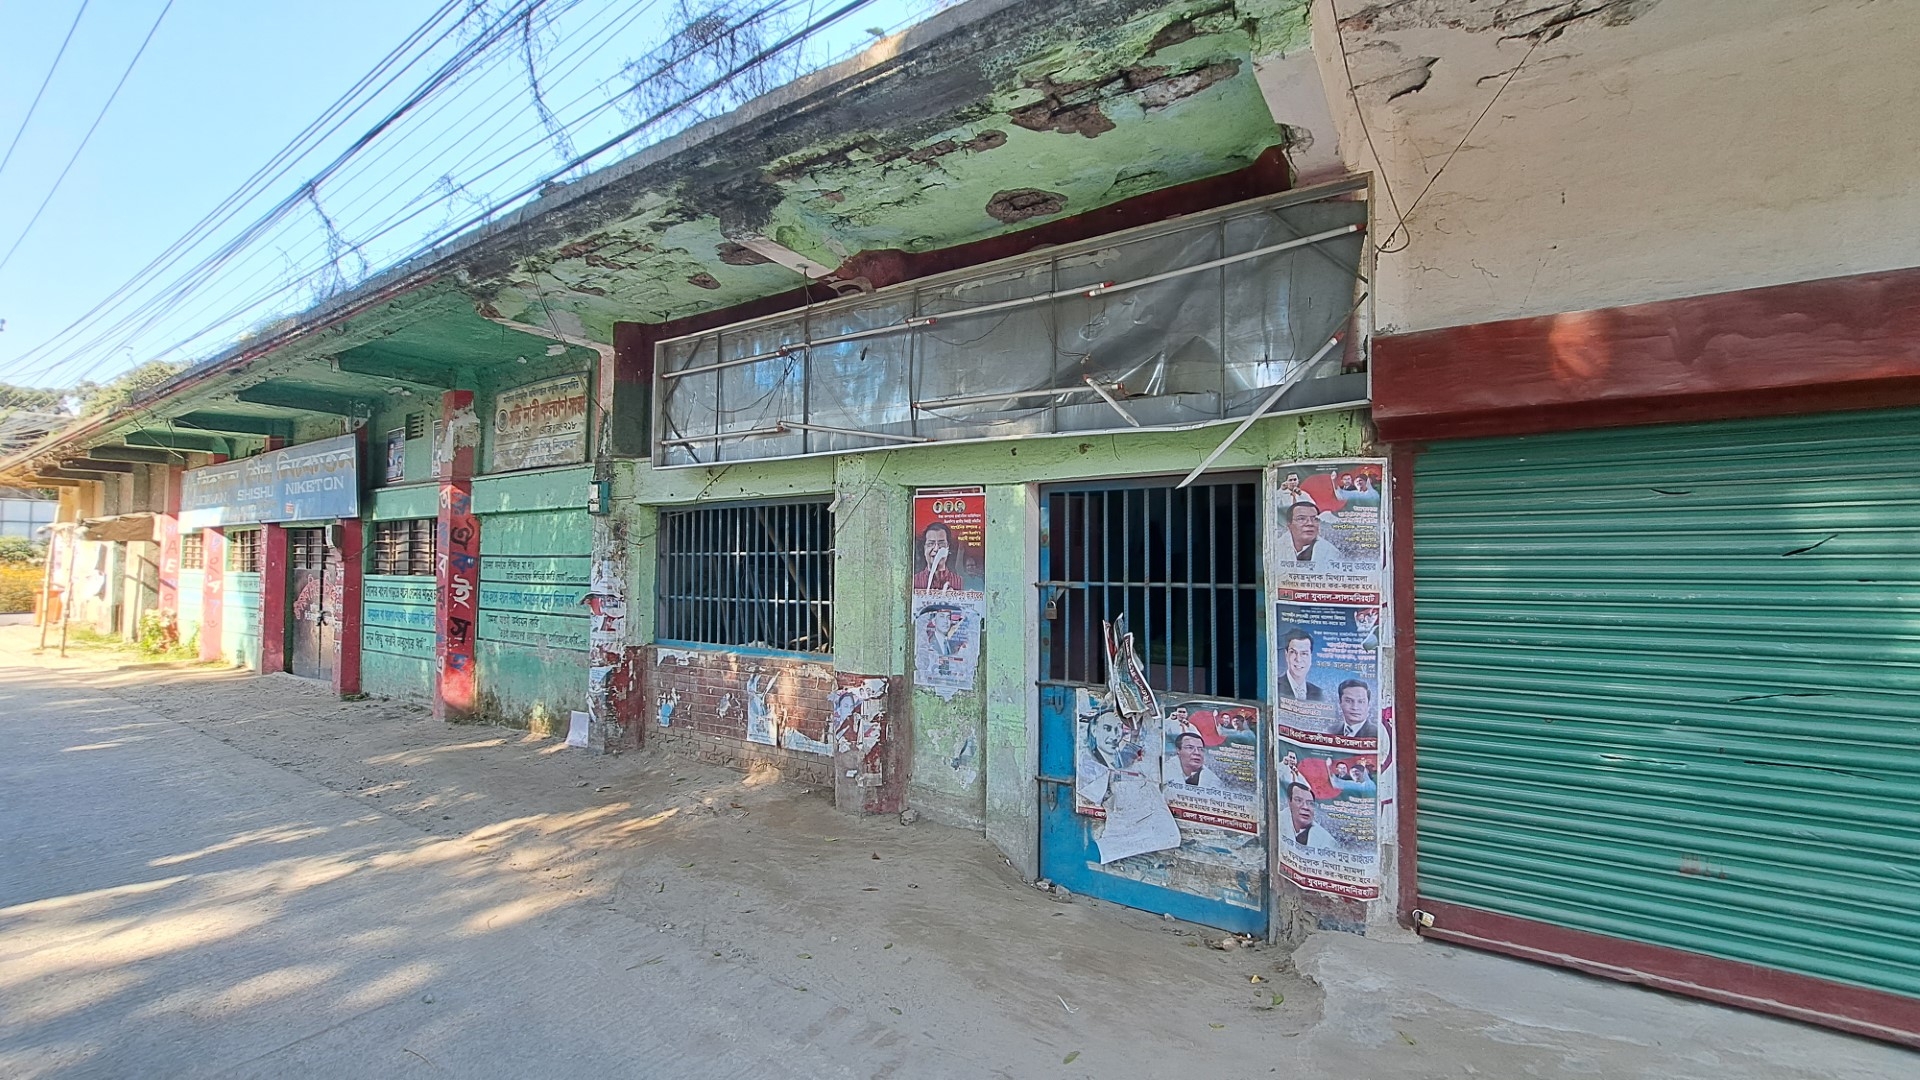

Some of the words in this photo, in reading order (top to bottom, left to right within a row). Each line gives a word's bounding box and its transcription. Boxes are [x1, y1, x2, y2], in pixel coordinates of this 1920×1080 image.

[237, 485, 274, 502] SHISHU
[285, 476, 344, 496] NIKETON
[1326, 572, 1344, 582] মিথ্যা
[1346, 574, 1368, 582] মামলা
[1334, 737, 1362, 748] উপজেলা
[1317, 846, 1336, 858] হাবিব
[1338, 851, 1350, 864] দুলু
[1351, 854, 1374, 864] ভাইয়ের
[1322, 860, 1341, 871] মিথ্যা
[1343, 866, 1366, 876] মামলা
